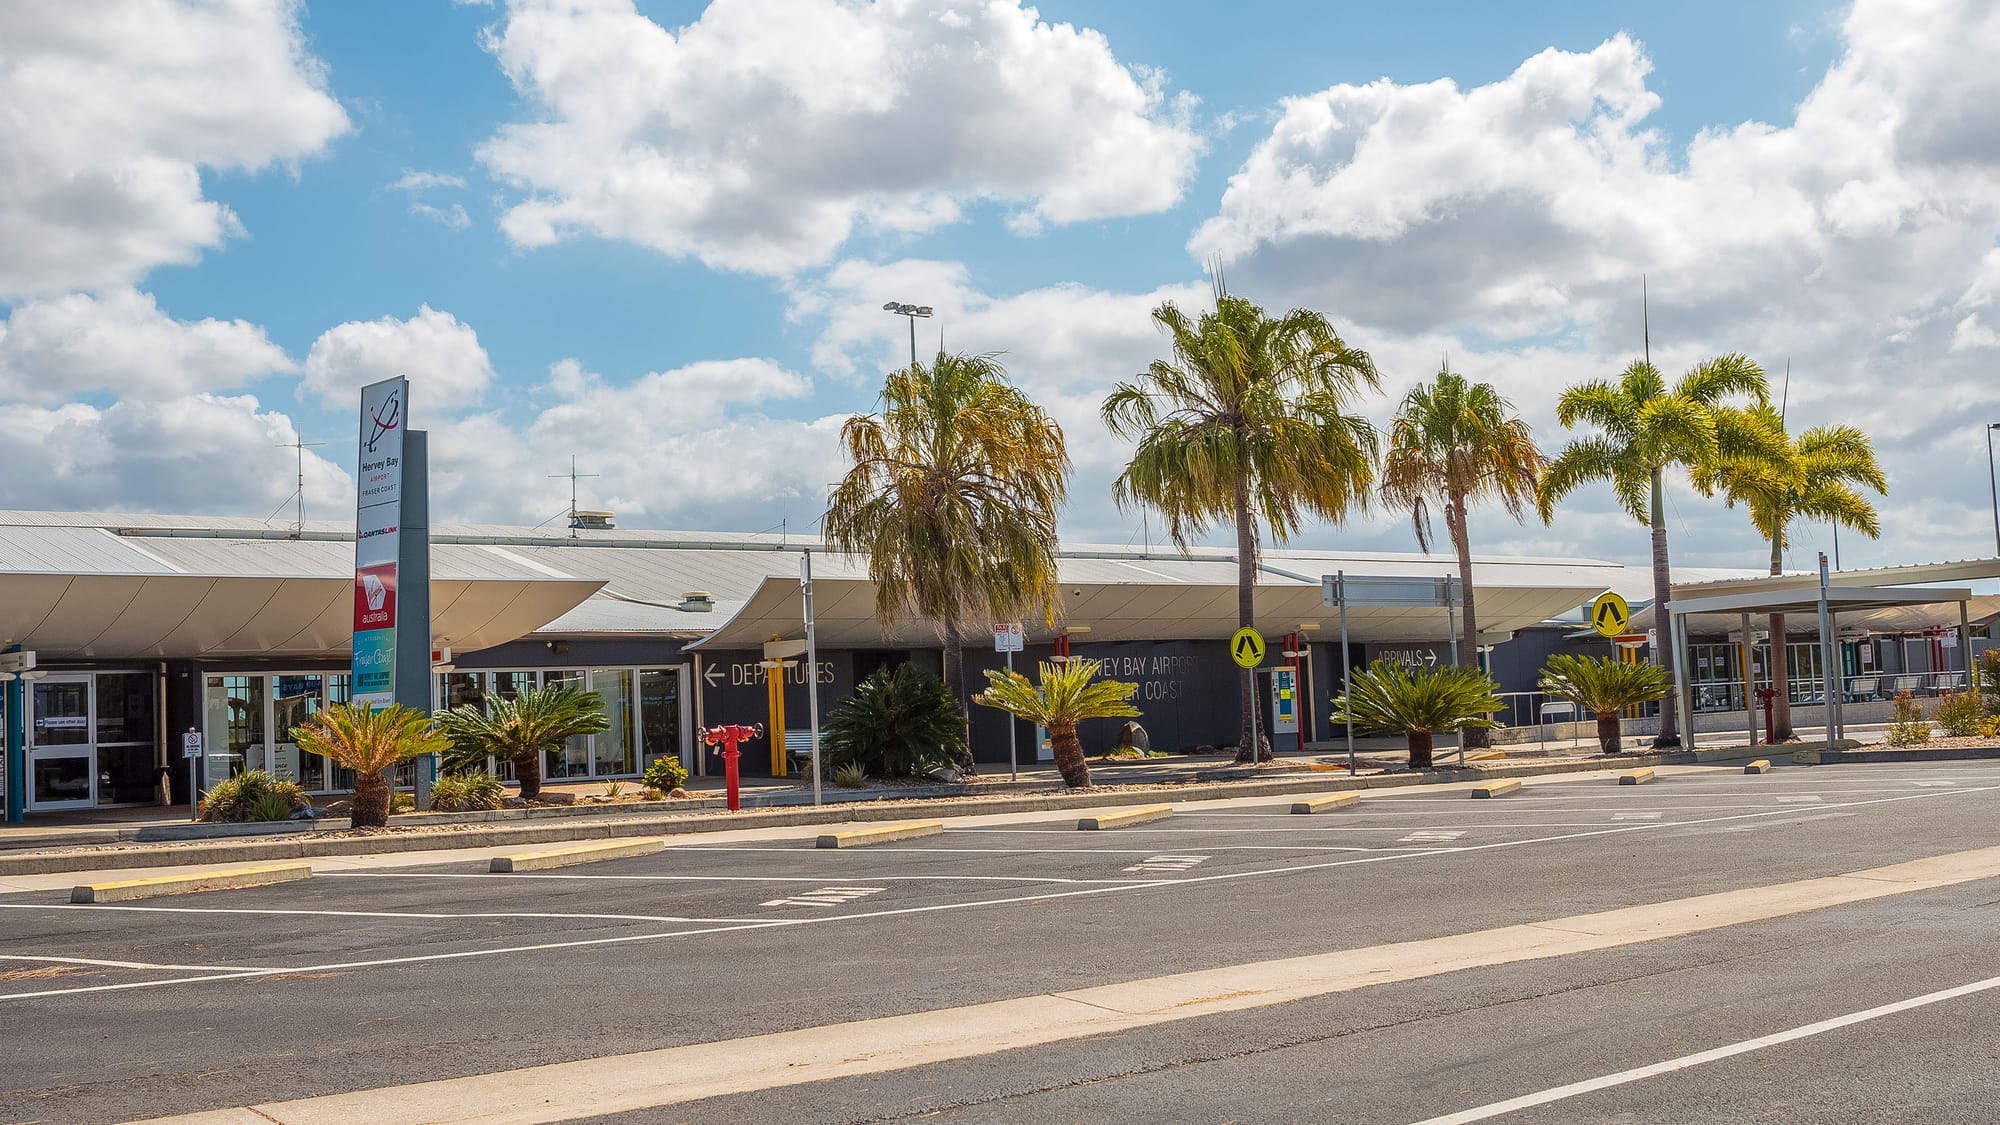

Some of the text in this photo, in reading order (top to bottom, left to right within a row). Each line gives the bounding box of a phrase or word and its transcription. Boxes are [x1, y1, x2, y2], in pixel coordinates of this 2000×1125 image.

[362, 457, 399, 473] Hervey Bay
[369, 473, 390, 482] AIRPORT
[362, 483, 397, 497] FRASER COAST
[362, 611, 388, 624] australia
[1378, 649, 1423, 667] ARRIVALS
[1123, 656, 1147, 677] BAY
[1145, 680, 1184, 700] COAST
